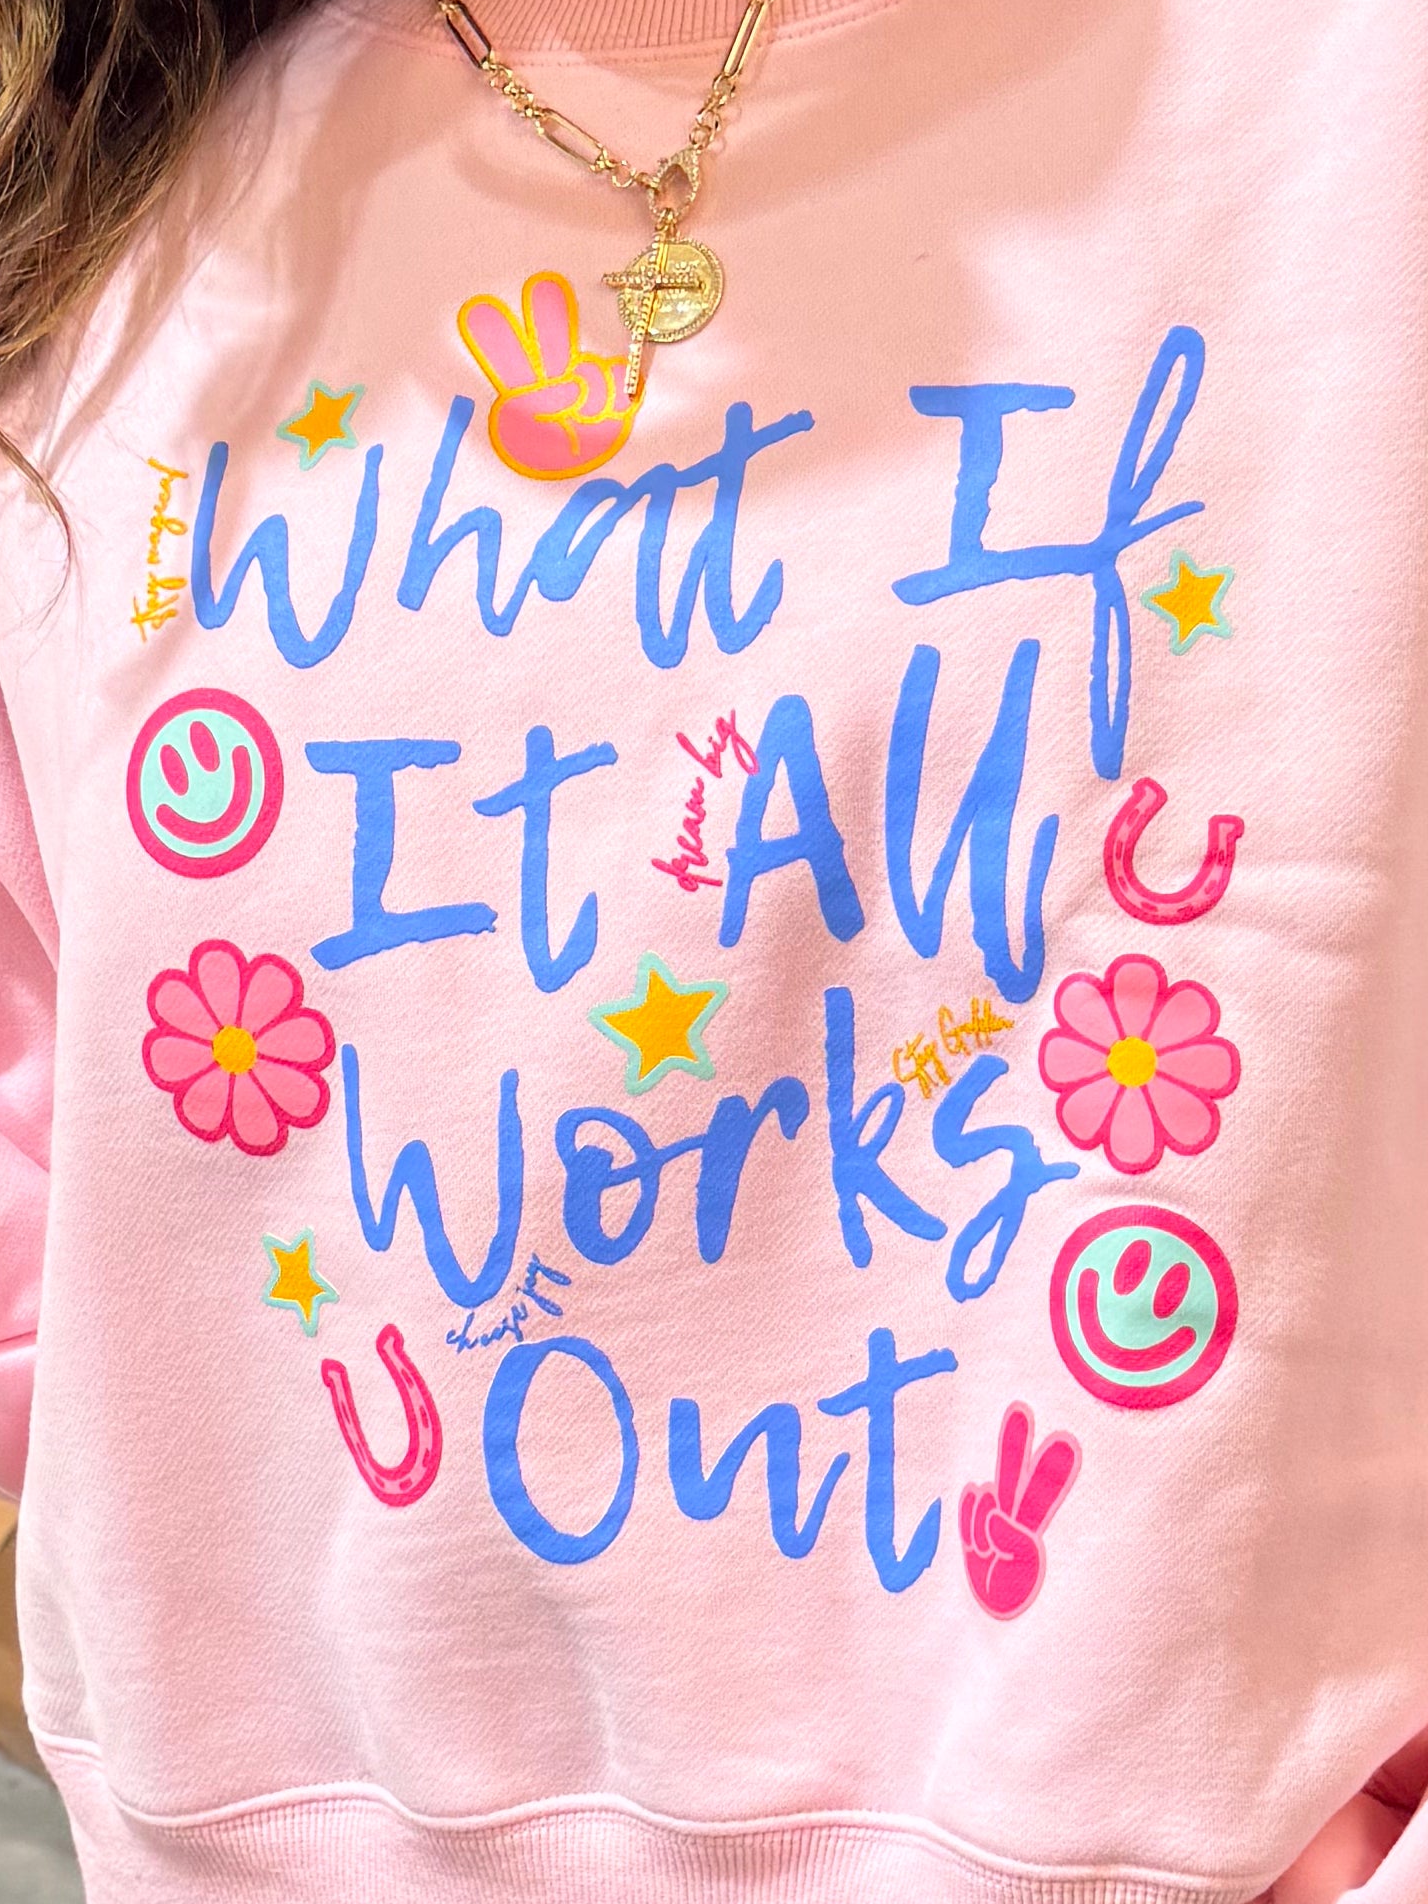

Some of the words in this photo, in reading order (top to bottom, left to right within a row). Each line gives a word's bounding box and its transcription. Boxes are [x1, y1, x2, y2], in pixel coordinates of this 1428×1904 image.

[191, 396, 814, 669] What
[892, 326, 1205, 780] If
[305, 726, 617, 993] It
[719, 640, 1059, 1004] All
[651, 776, 724, 892] dream
[675, 708, 760, 780] big
[342, 987, 1079, 1309] Works
[483, 1328, 957, 1594] Out
